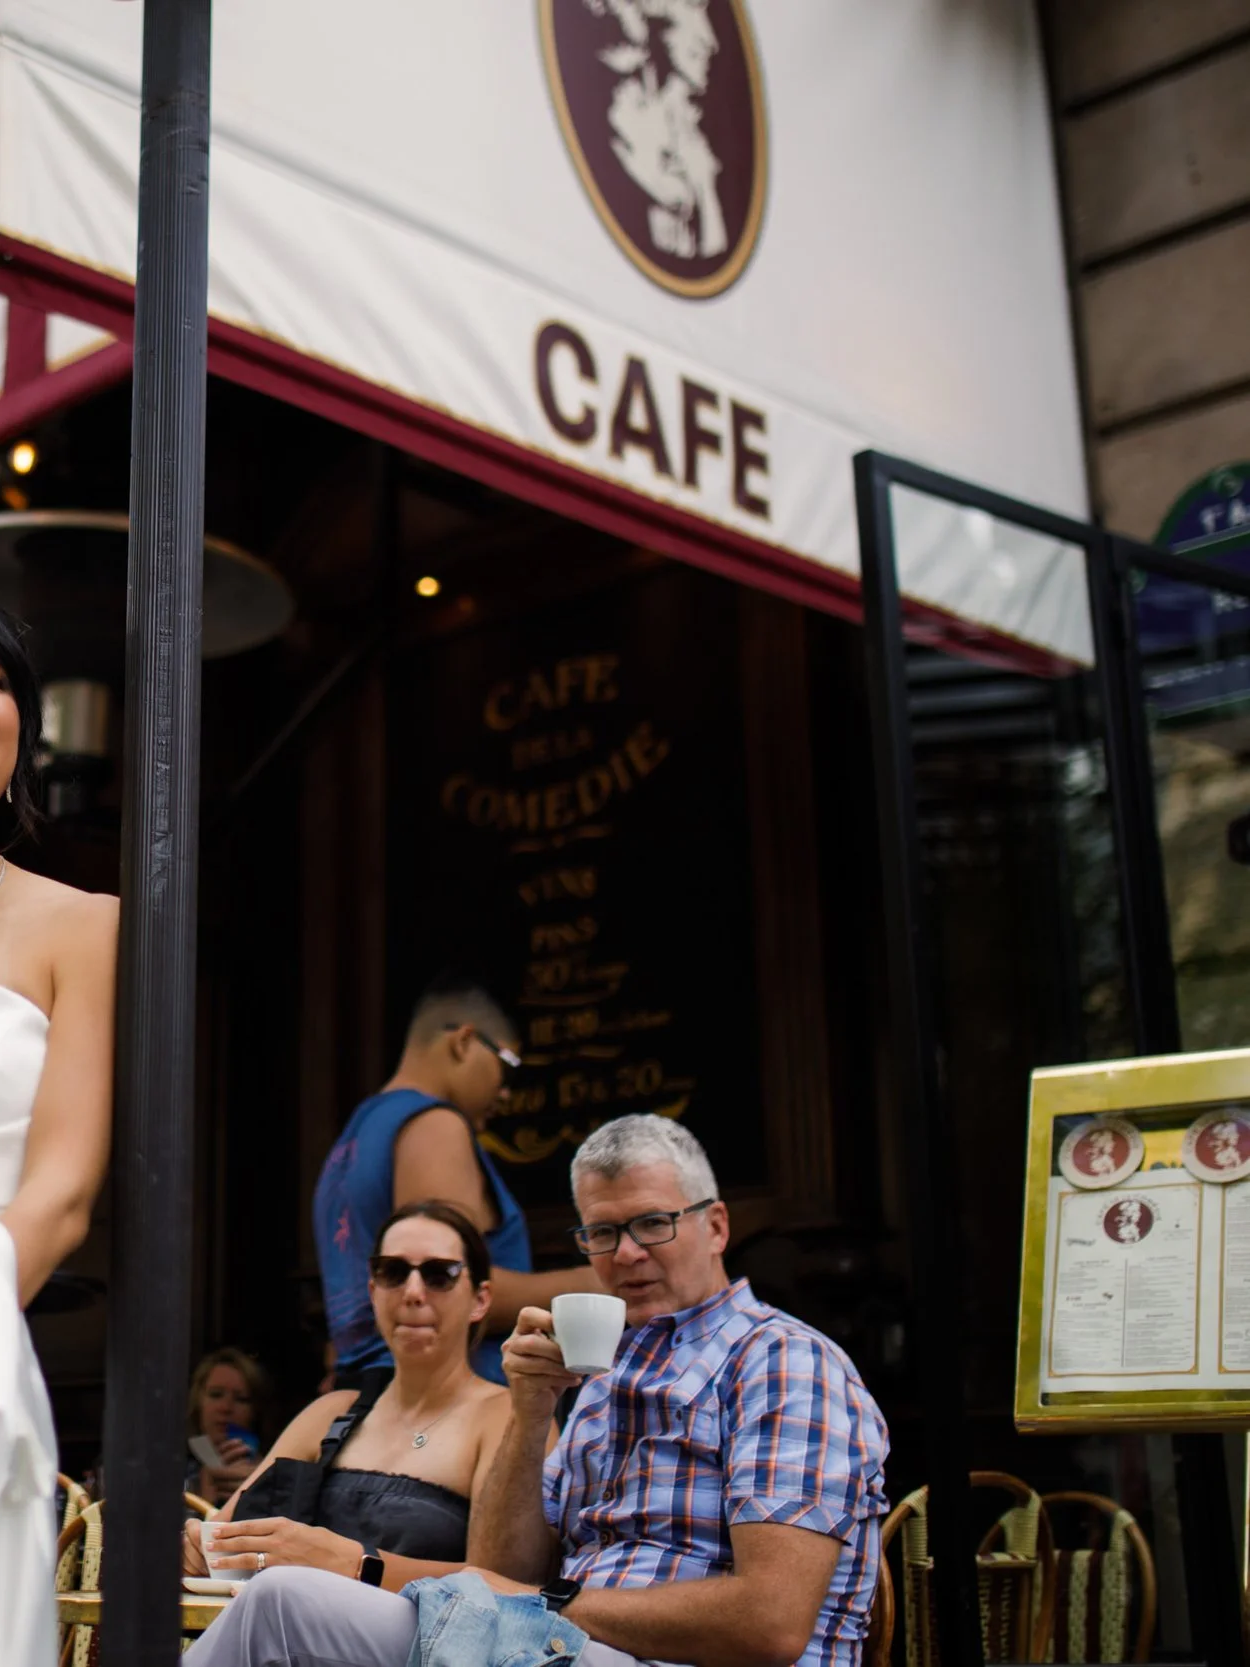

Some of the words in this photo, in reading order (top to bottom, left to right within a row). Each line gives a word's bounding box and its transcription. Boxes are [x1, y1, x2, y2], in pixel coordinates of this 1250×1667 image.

[533, 318, 770, 522] CAFE
[483, 653, 620, 731] CAFE
[441, 721, 671, 830] COMEDIE
